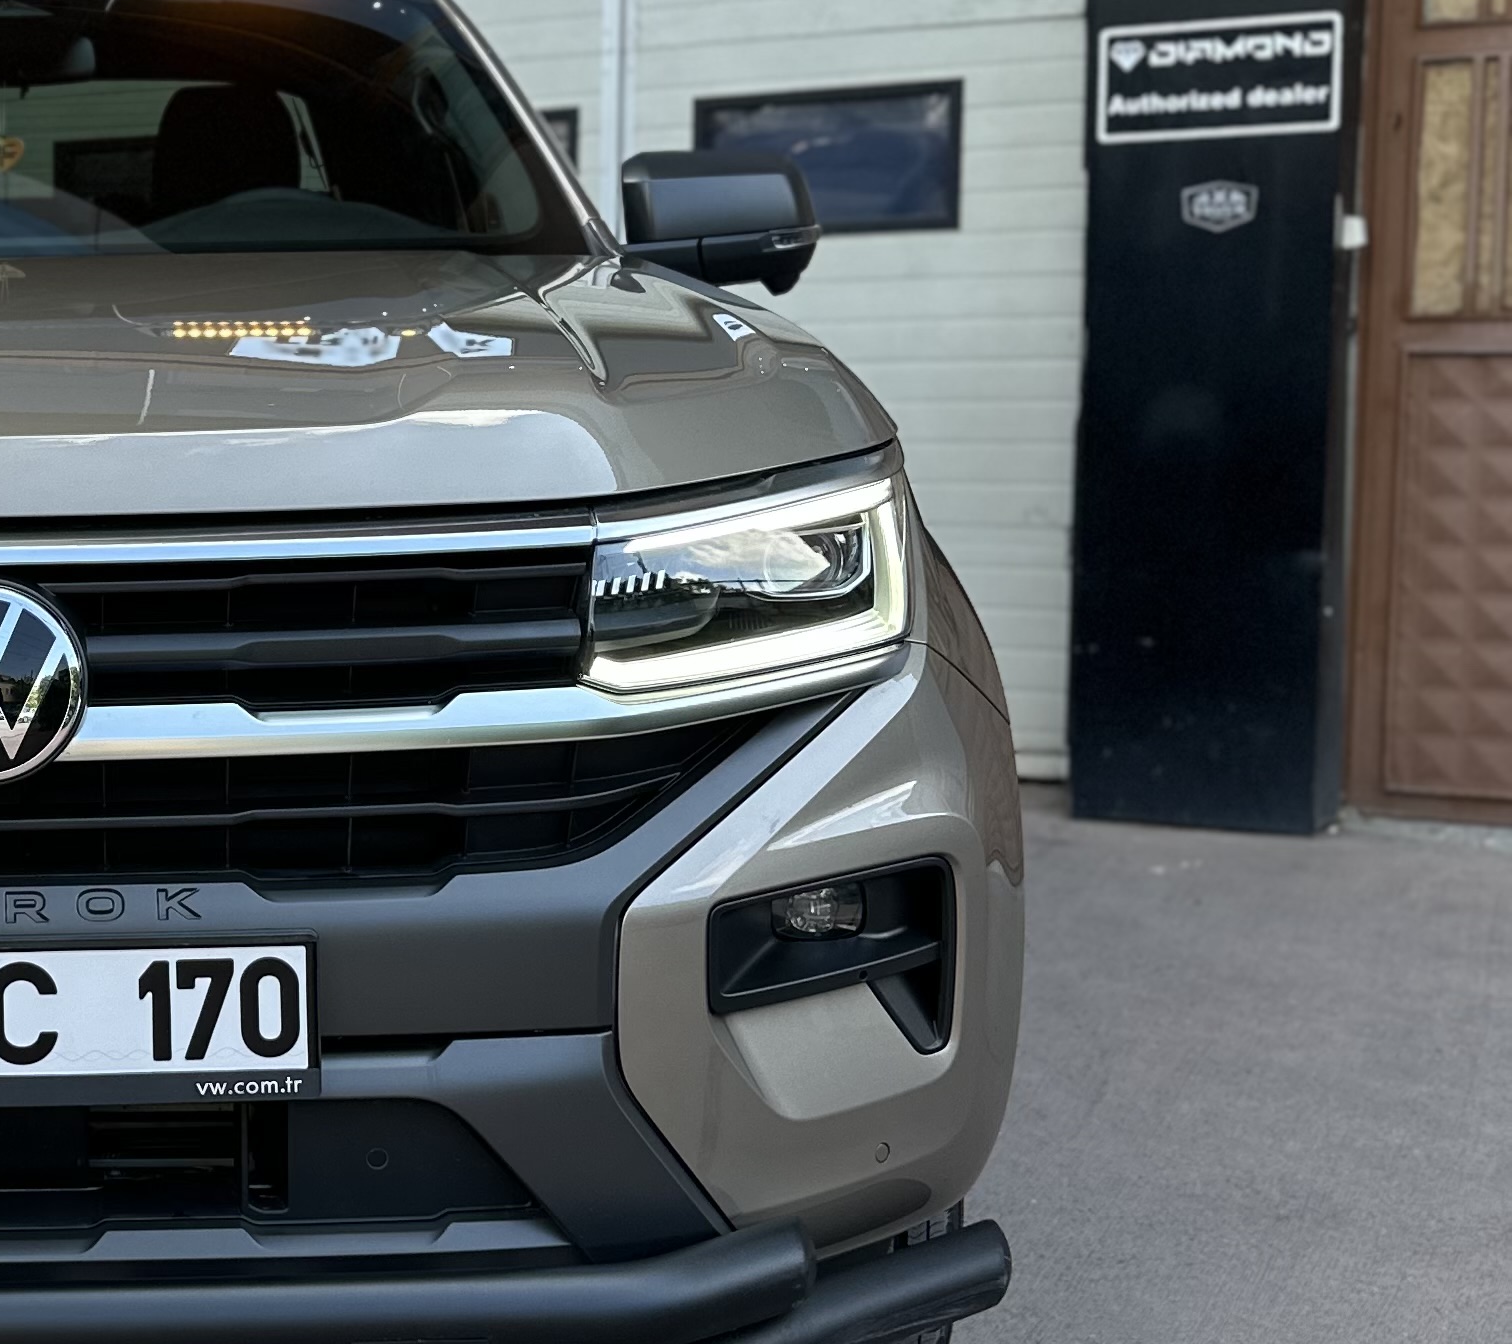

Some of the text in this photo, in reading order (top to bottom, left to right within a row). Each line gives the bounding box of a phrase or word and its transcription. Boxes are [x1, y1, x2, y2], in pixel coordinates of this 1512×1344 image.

[1108, 83, 1330, 116] Authorized dealer
[139, 956, 300, 1061] 170
[195, 1076, 303, 1096] vw.com.tr
